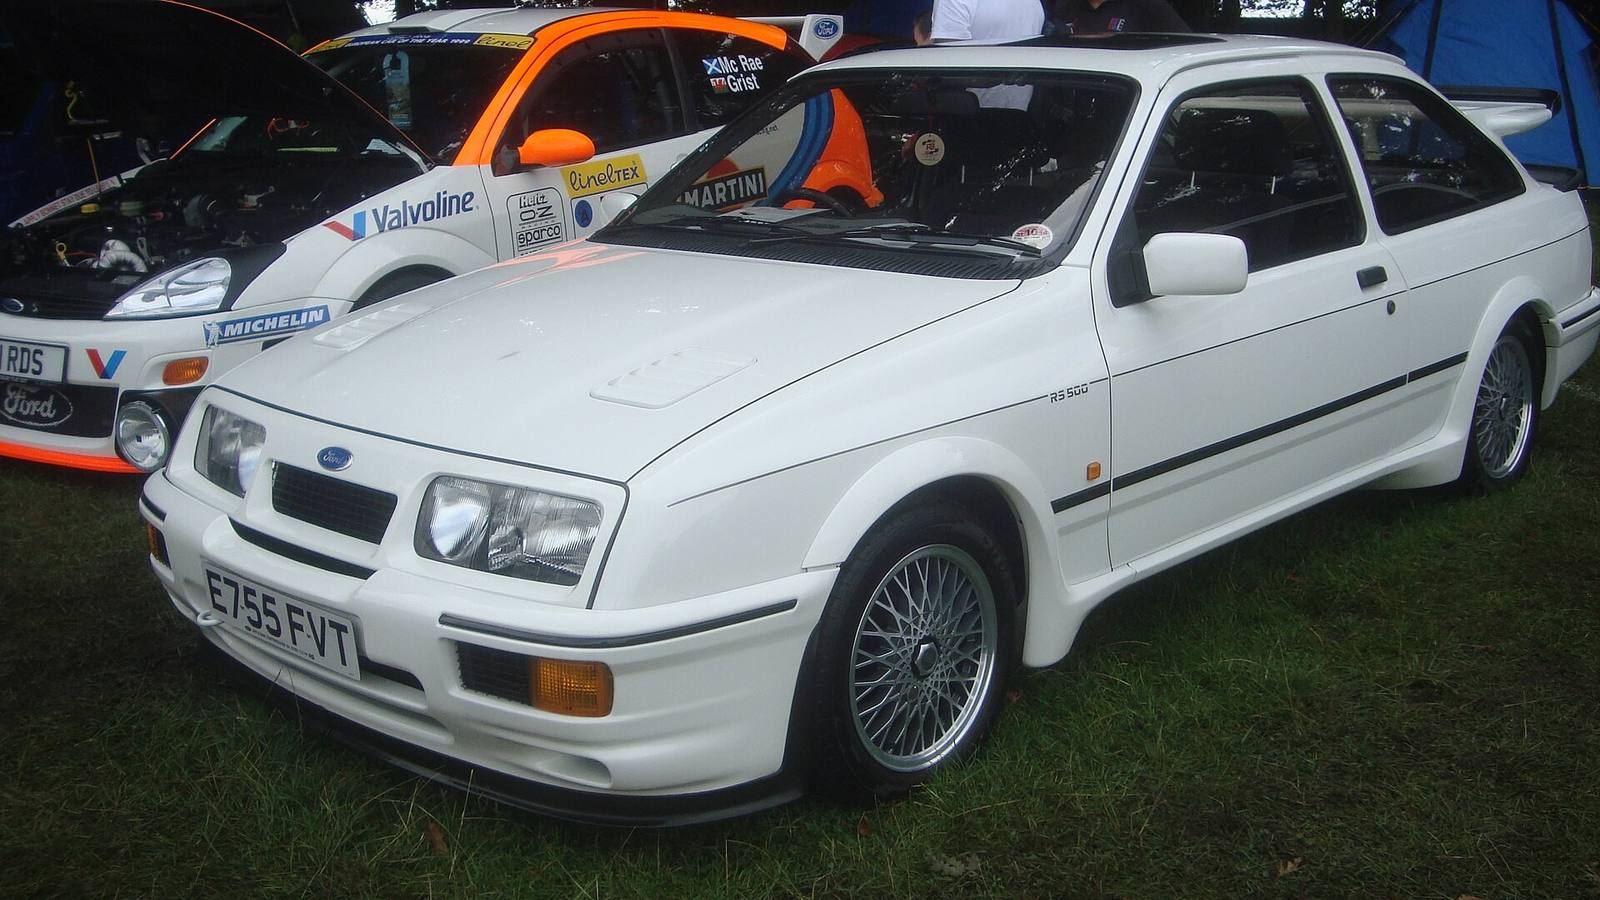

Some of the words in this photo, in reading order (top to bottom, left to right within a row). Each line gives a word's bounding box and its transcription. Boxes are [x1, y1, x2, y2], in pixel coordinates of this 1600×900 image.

[817, 21, 835, 36] Ford
[718, 56, 739, 74] Mc
[740, 54, 764, 71] Rae
[726, 73, 760, 93] Grist
[684, 171, 765, 208] MARTINI
[371, 190, 475, 233] Valvoline
[518, 225, 561, 247] sparco
[223, 308, 325, 337] MICHELIN
[6, 345, 44, 376] RDS
[4, 383, 57, 419] Ford
[1066, 383, 1089, 398] 500
[205, 568, 282, 638] E755
[285, 602, 349, 667] FVT
